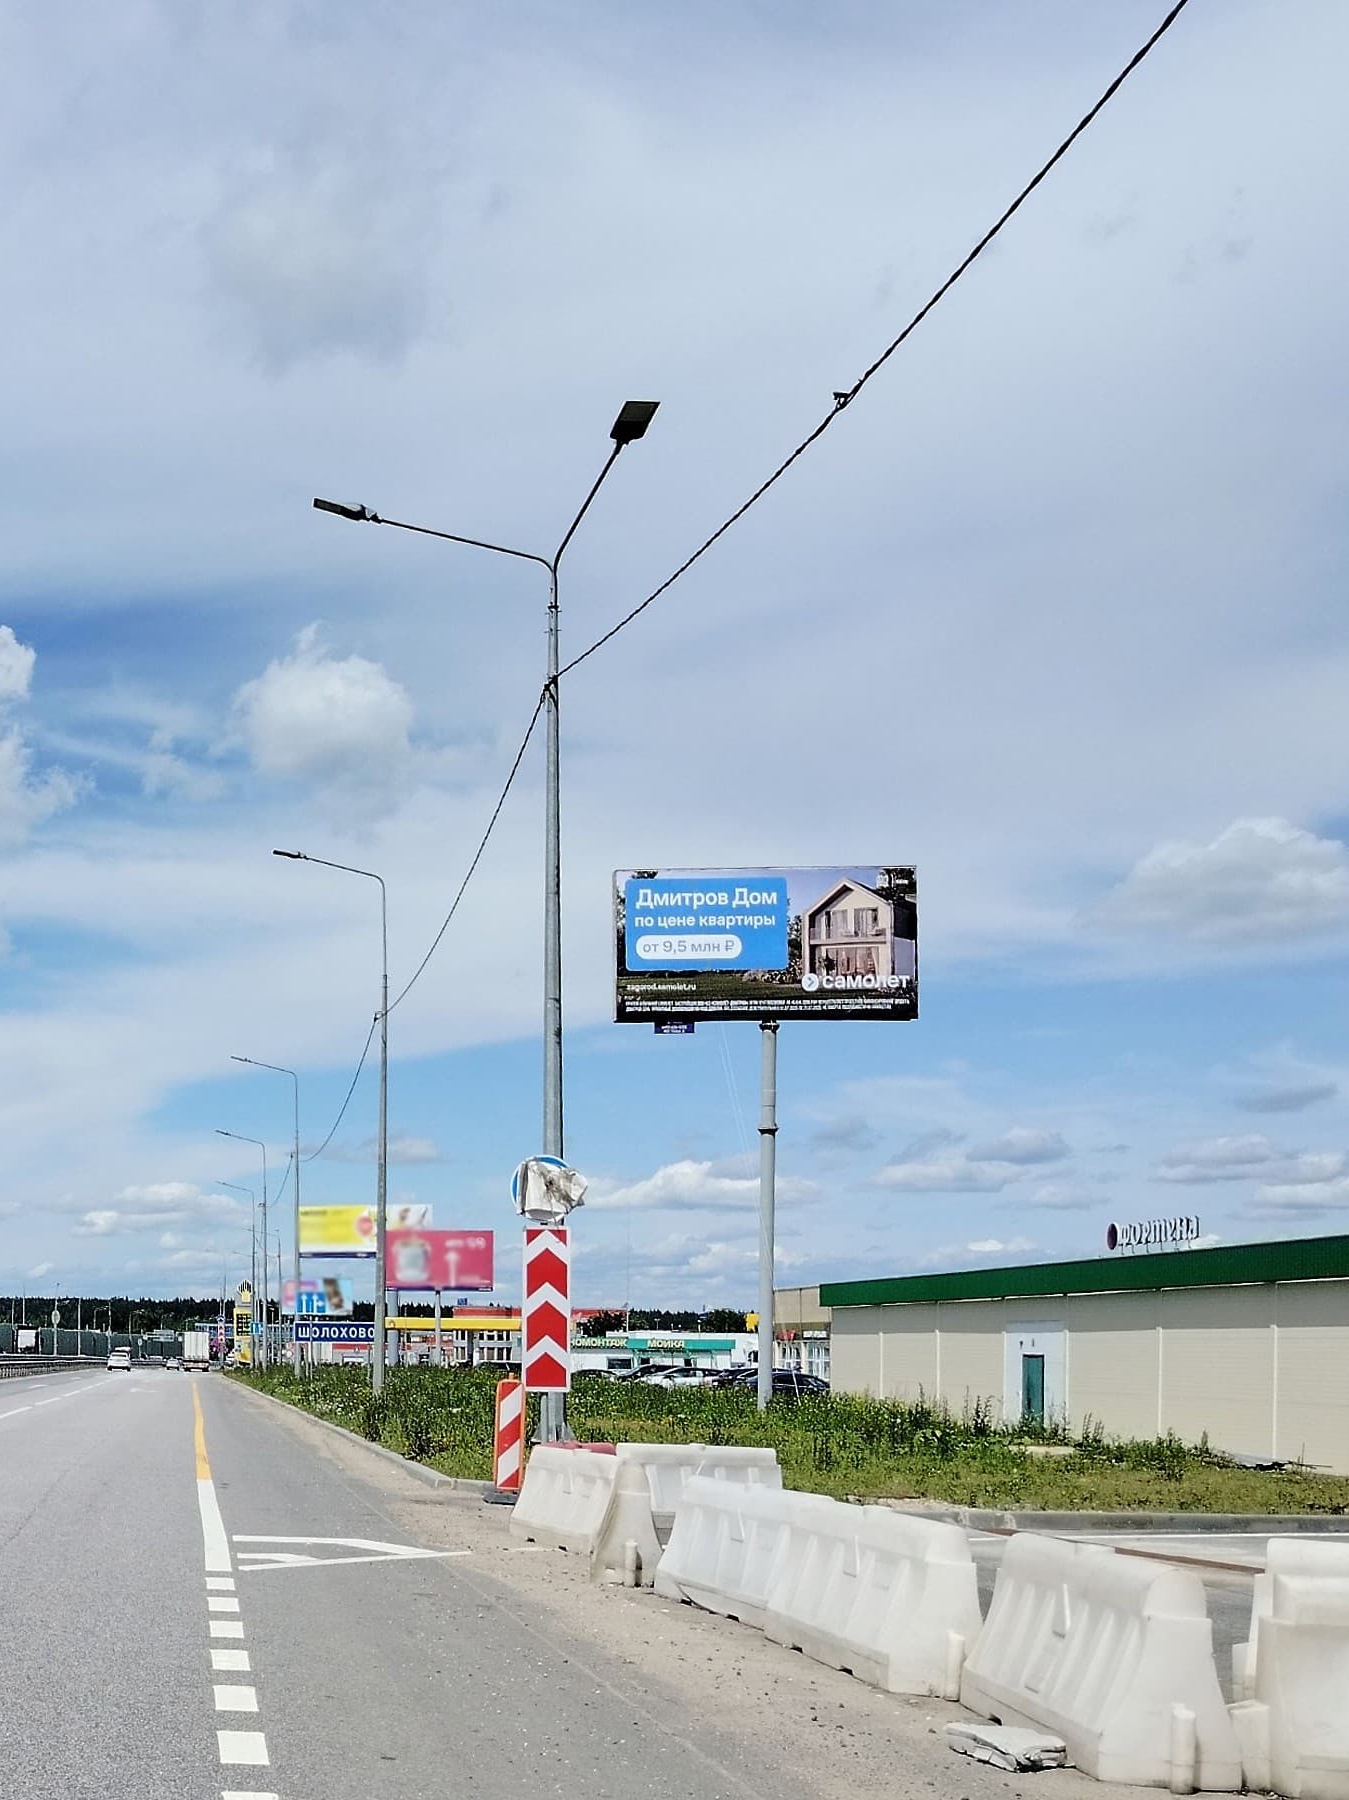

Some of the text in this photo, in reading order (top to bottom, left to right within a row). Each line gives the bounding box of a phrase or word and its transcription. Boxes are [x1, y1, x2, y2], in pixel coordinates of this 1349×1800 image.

[635, 887, 778, 910] Дмитров Дом
[634, 915, 776, 929] по цене квартиры
[642, 943, 659, 953] от
[662, 940, 687, 954] 9,5
[691, 943, 721, 953] млн
[822, 974, 910, 989] самолет
[298, 1326, 376, 1339] ШОЛОХОВО
